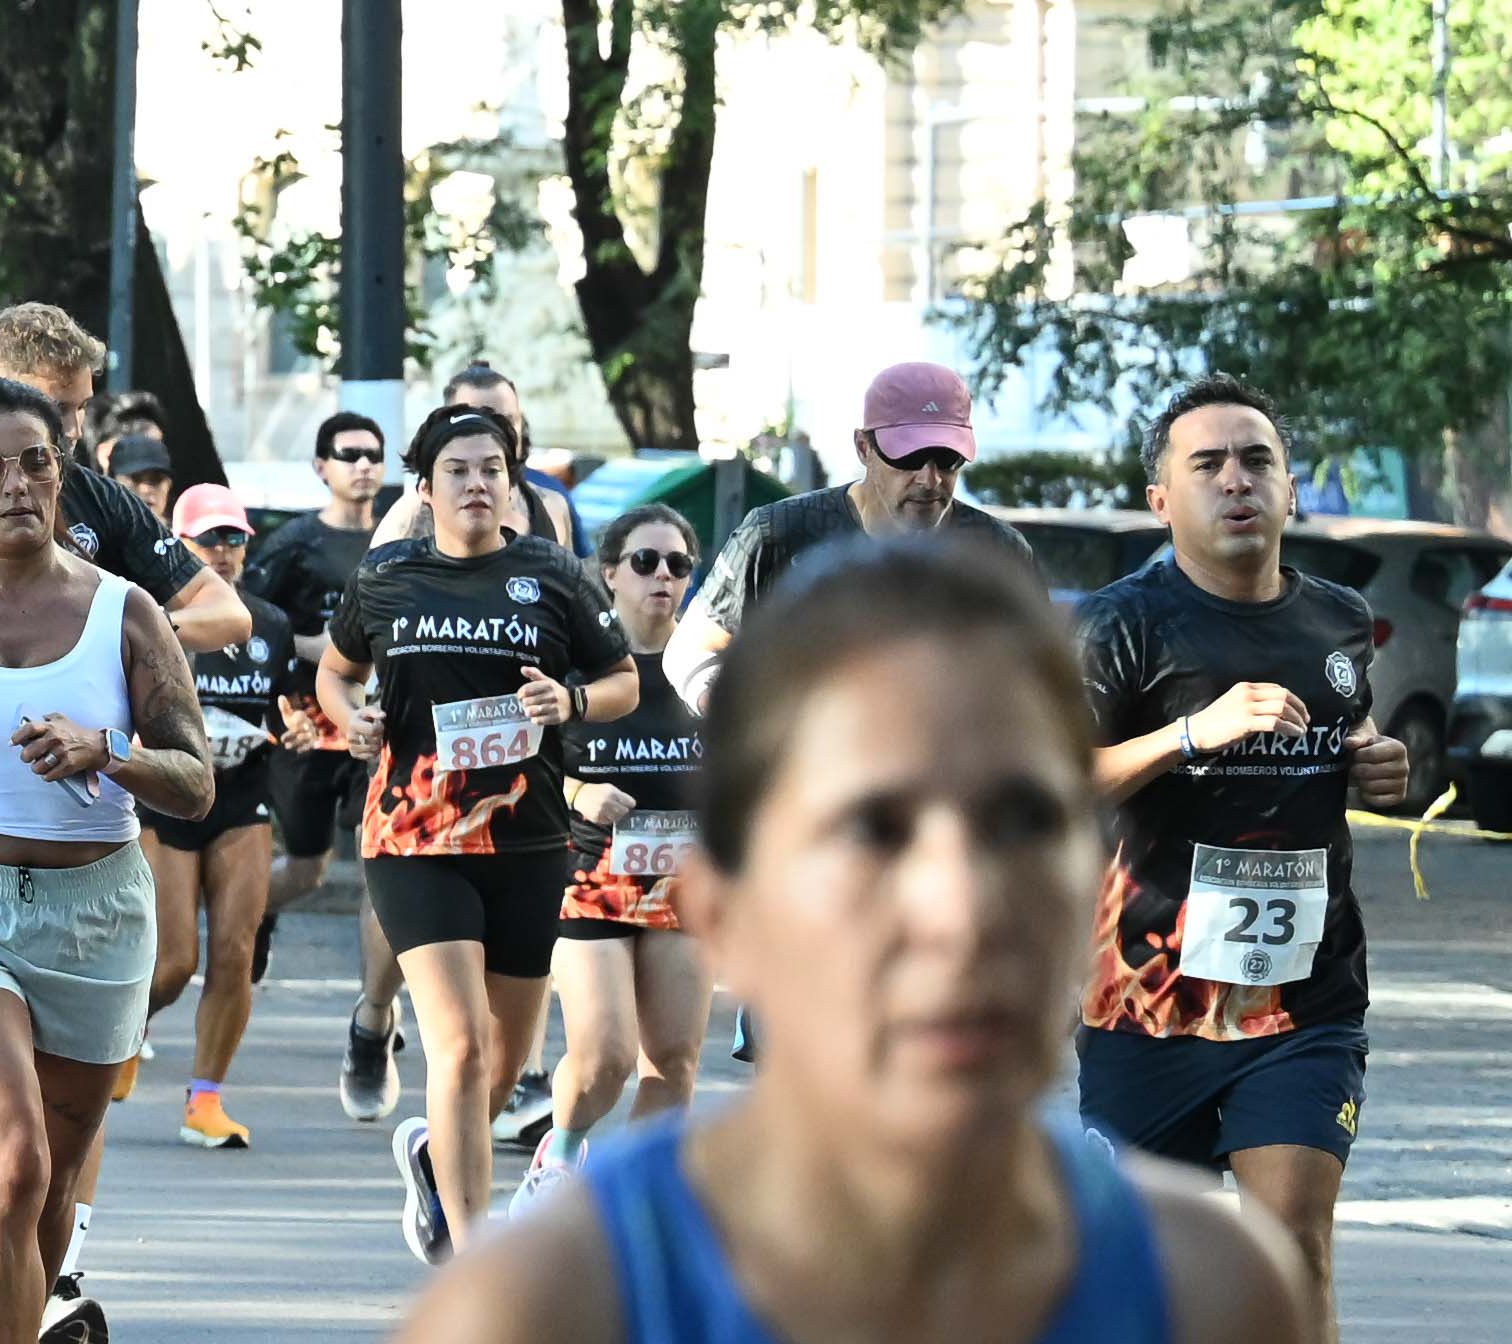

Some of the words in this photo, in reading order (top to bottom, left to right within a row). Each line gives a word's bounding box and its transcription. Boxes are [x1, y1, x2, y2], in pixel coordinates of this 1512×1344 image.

[392, 617, 409, 642] 1°
[415, 614, 539, 648] MARATÓN
[195, 670, 272, 695] MARATÓN
[207, 734, 254, 758] 18
[451, 728, 531, 770] 864
[586, 737, 608, 762] 1°
[615, 730, 705, 761] MARATÓ
[1220, 716, 1350, 757] MARATÓ
[1225, 765, 1278, 777] BOMBEROS
[1215, 857, 1232, 874] 1°
[1235, 856, 1315, 879] MARATÓN
[1223, 897, 1297, 945] 23
